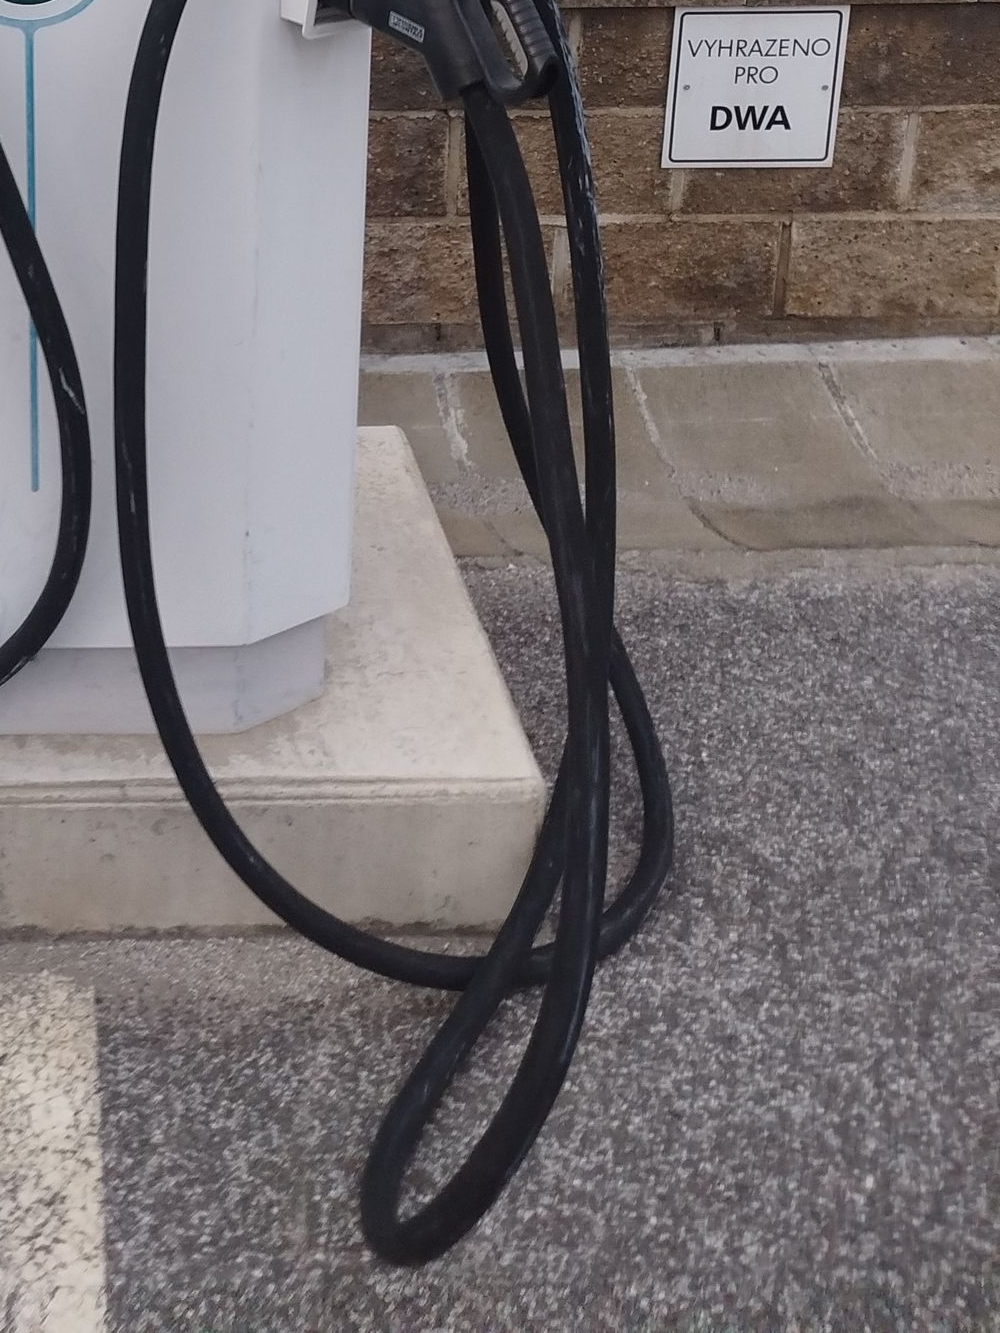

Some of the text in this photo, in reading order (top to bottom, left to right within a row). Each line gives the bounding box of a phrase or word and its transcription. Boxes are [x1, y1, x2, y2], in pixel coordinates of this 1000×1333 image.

[687, 38, 831, 58] VYHRAZENO
[734, 66, 779, 84] PRO
[709, 105, 792, 131] DWA
